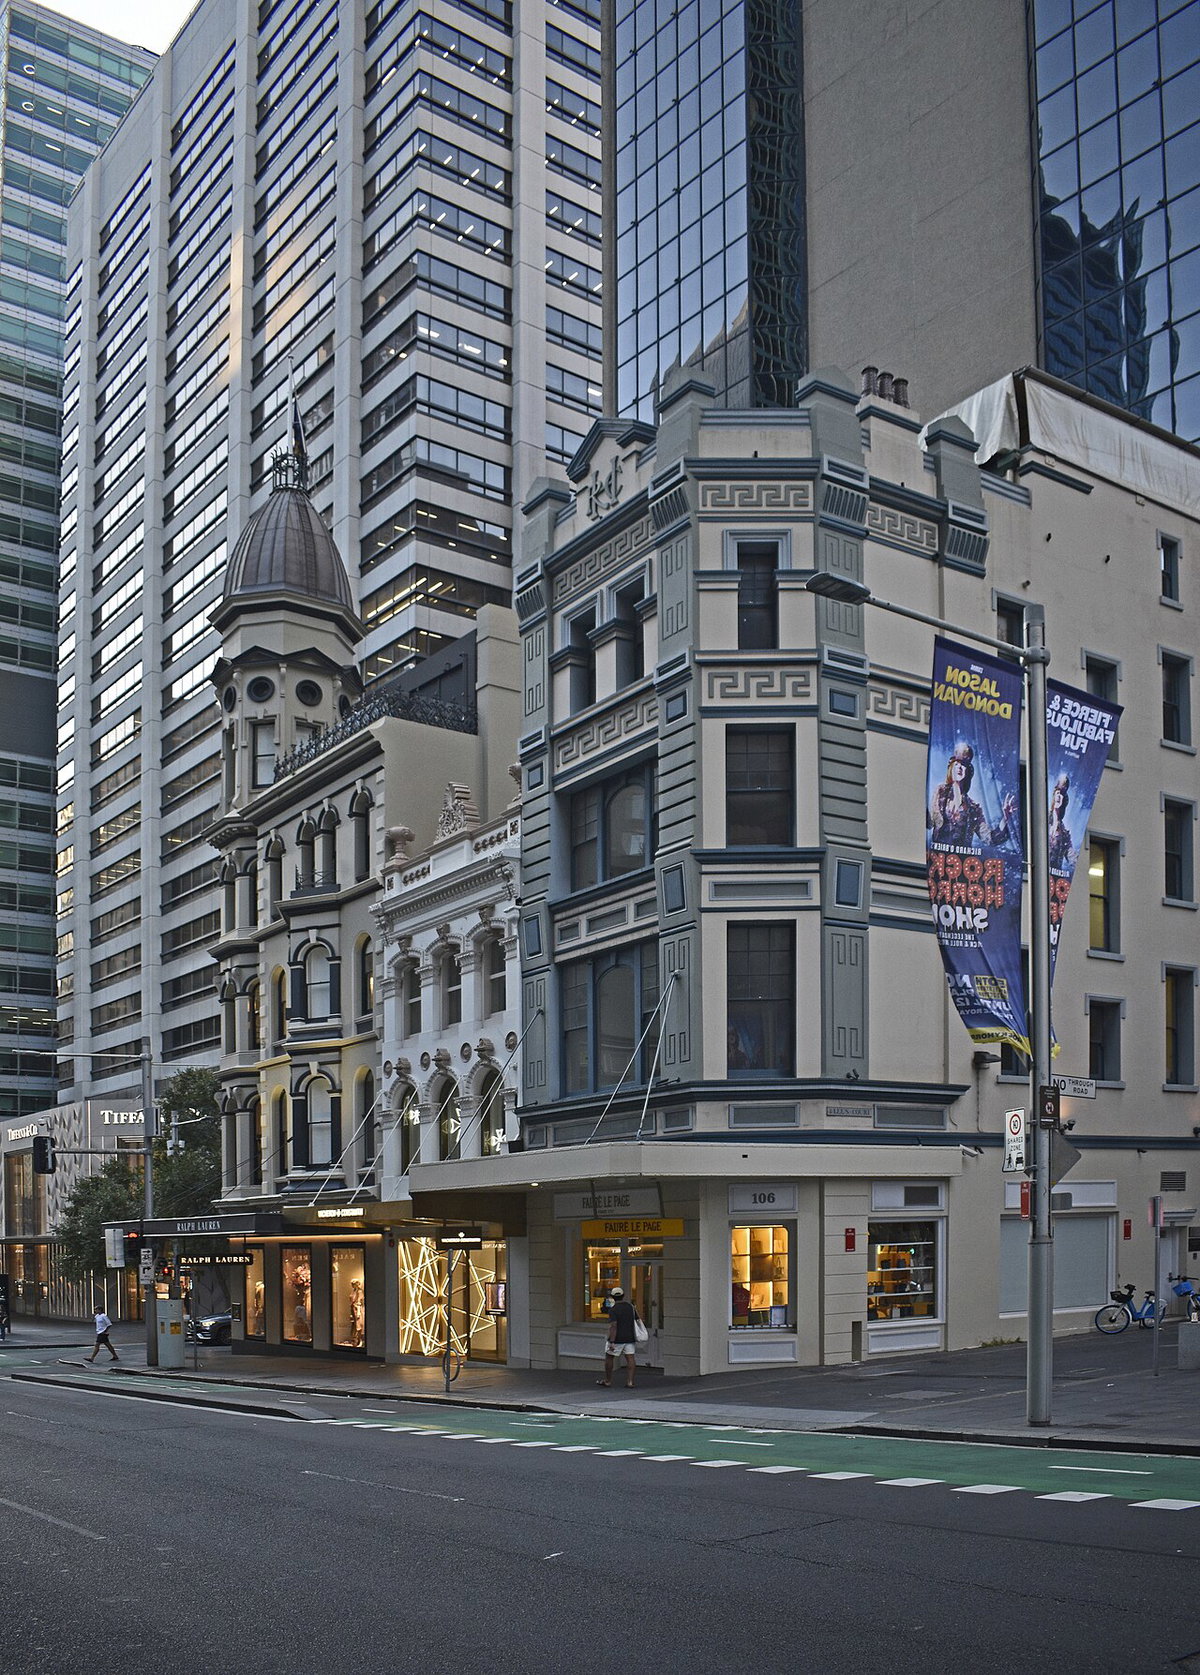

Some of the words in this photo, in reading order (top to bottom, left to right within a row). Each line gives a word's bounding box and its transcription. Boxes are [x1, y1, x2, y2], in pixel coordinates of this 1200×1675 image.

[1053, 1079, 1067, 1091] NO
[1068, 1078, 1094, 1087] THROUGH
[1073, 1087, 1089, 1095] ROAD
[100, 1110, 147, 1125] TIFFA
[604, 1196, 613, 1208] LE
[614, 1195, 631, 1207] PAGE
[751, 1192, 776, 1204] 106
[176, 1222, 196, 1232] RALPH
[198, 1221, 221, 1231] LAUREN
[631, 1222, 641, 1232] LE
[643, 1221, 662, 1232] PAGE
